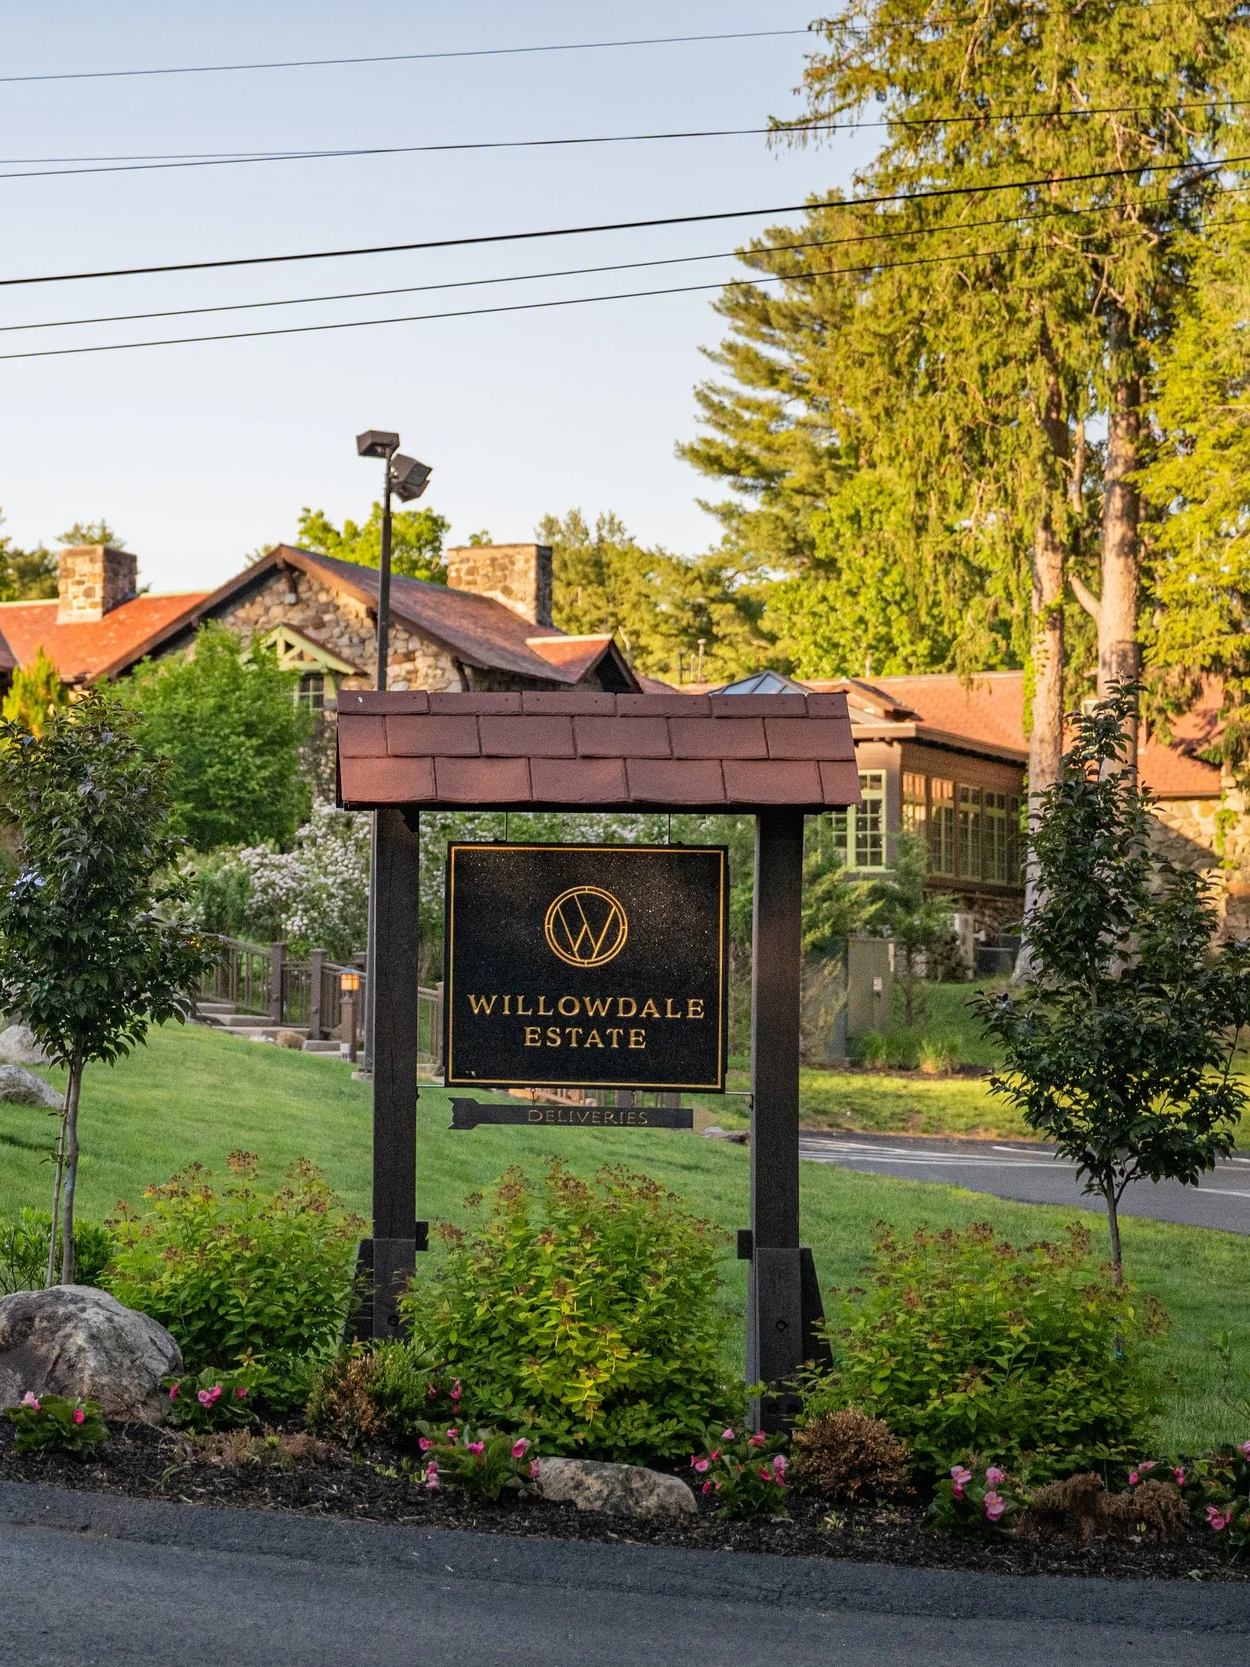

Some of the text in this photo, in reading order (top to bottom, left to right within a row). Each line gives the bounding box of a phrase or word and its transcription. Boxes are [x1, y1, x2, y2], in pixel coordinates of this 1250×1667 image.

[556, 893, 617, 961] W
[467, 993, 706, 1019] WILLOWDALE
[523, 1026, 647, 1049] ESTATE
[527, 1109, 648, 1125] DELIVERIES
